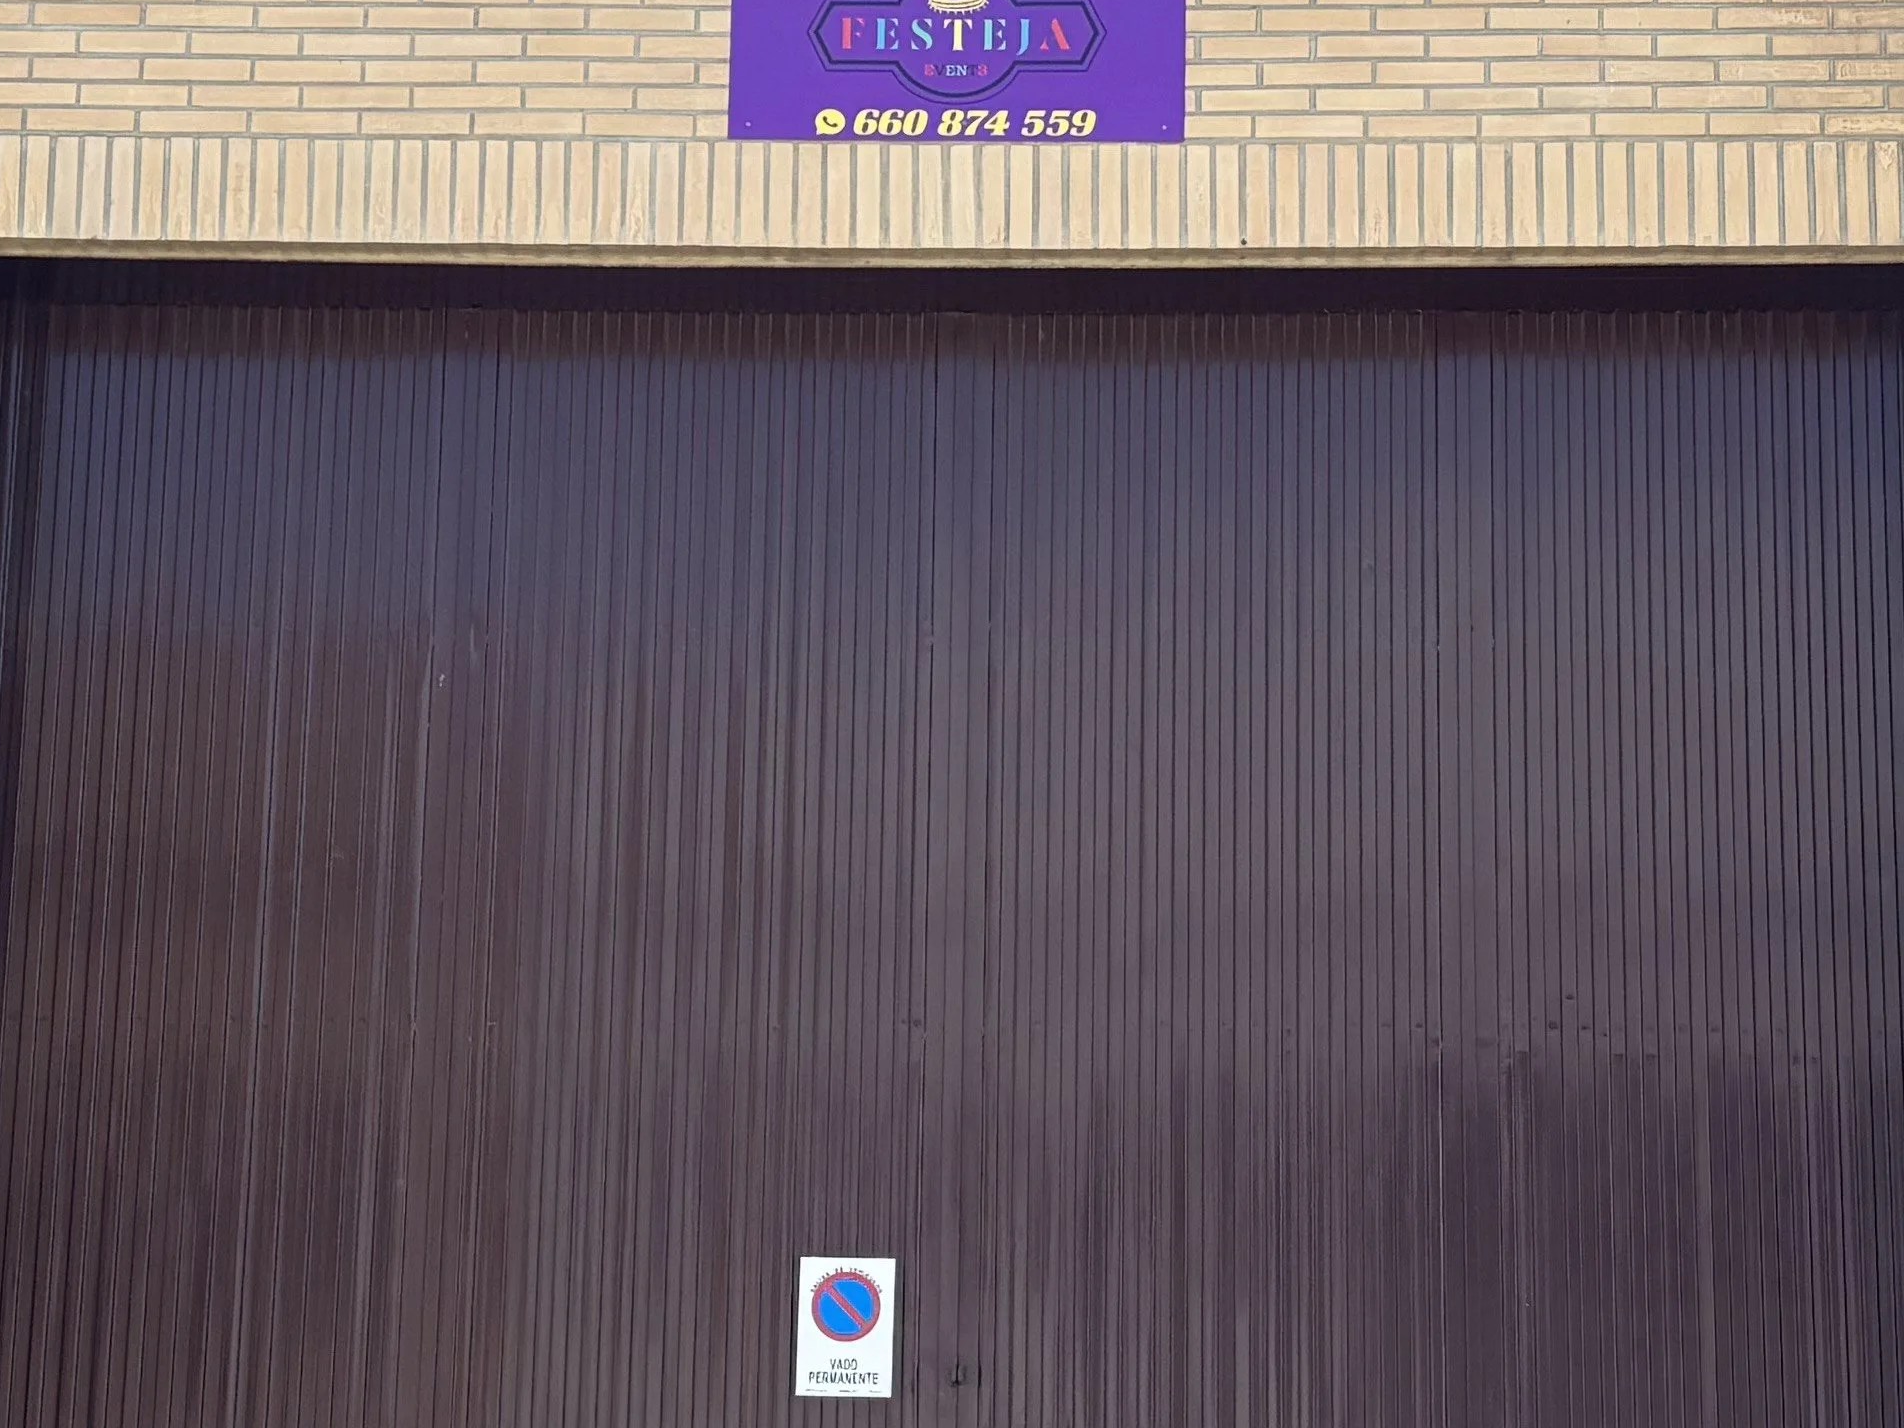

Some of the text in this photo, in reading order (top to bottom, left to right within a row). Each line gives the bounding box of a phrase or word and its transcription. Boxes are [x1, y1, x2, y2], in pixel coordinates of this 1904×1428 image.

[842, 17, 1070, 55] FESTEJA
[853, 108, 1097, 137] 660 874 559
[830, 1358, 857, 1370] VADO
[809, 1372, 878, 1384] PERMANENTE
